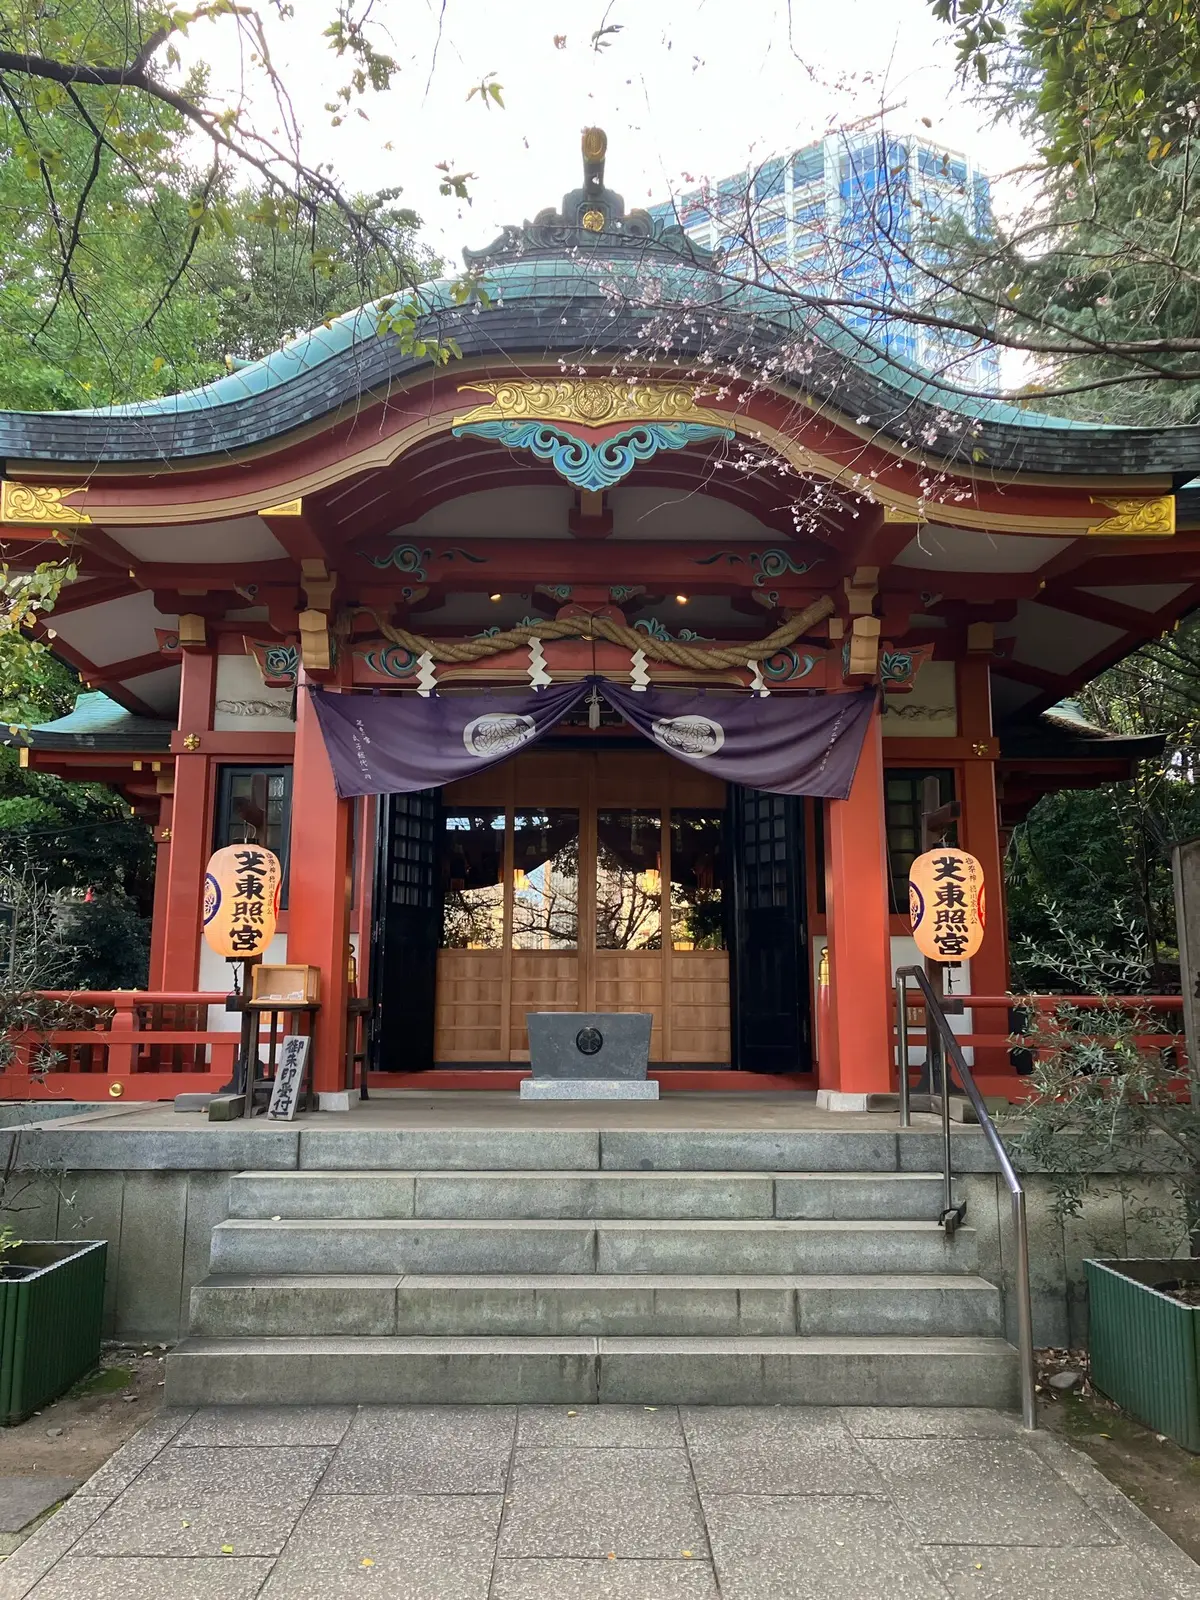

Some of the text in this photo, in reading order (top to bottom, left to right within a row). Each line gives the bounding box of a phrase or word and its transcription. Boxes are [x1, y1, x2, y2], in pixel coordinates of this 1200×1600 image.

[229, 851, 268, 952] 芝東照宮
[931, 856, 969, 956] 芝東照宮
[273, 1039, 305, 1112] 御朱印受付
